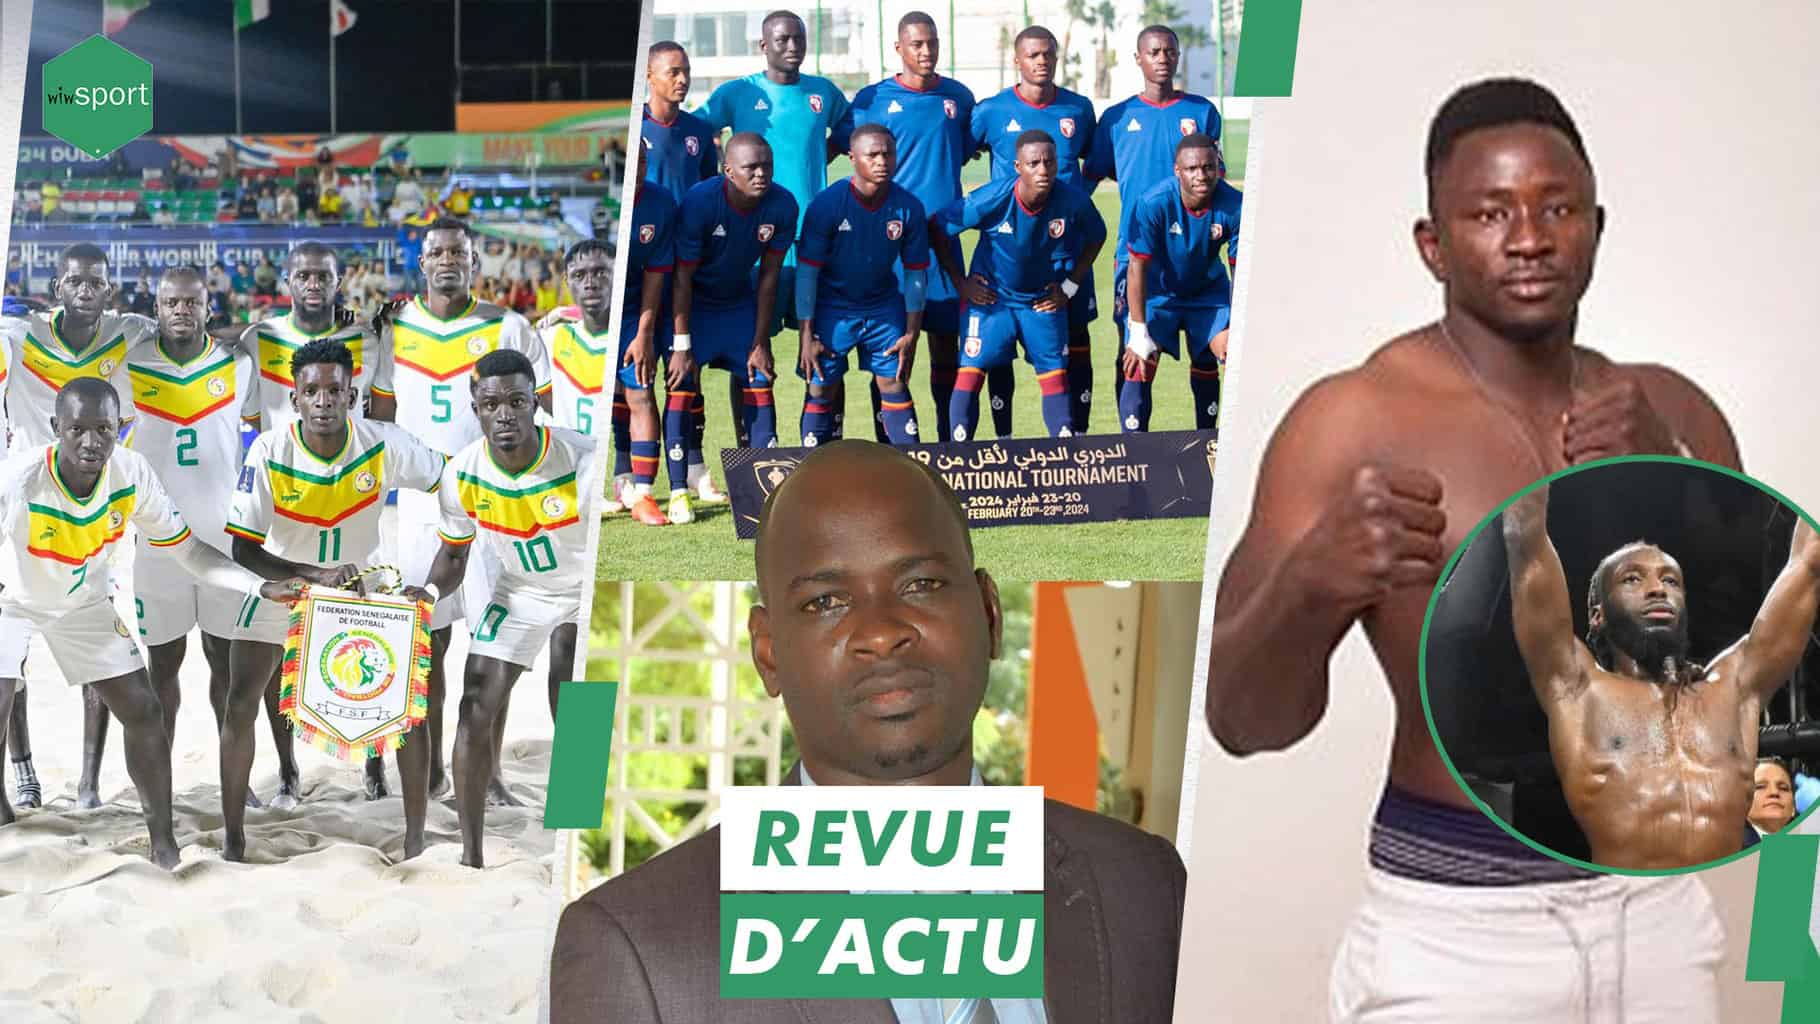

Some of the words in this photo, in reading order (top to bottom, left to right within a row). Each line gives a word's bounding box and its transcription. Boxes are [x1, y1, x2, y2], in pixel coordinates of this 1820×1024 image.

[431, 385, 452, 423] 5
[577, 398, 593, 435] 6
[176, 428, 198, 466] 2
[1013, 447, 1069, 470] الدولي
[1074, 443, 1126, 468] الدوري
[937, 453, 964, 470] من
[1030, 464, 1149, 487] TOURNAMENT
[968, 495, 1003, 507] 2024
[968, 507, 1018, 519] FEBRUARY
[318, 528, 341, 562] 11
[513, 536, 557, 573] 10
[67, 563, 88, 595] 7
[338, 616, 349, 625] DE
[350, 618, 385, 629] FOOTBALL
